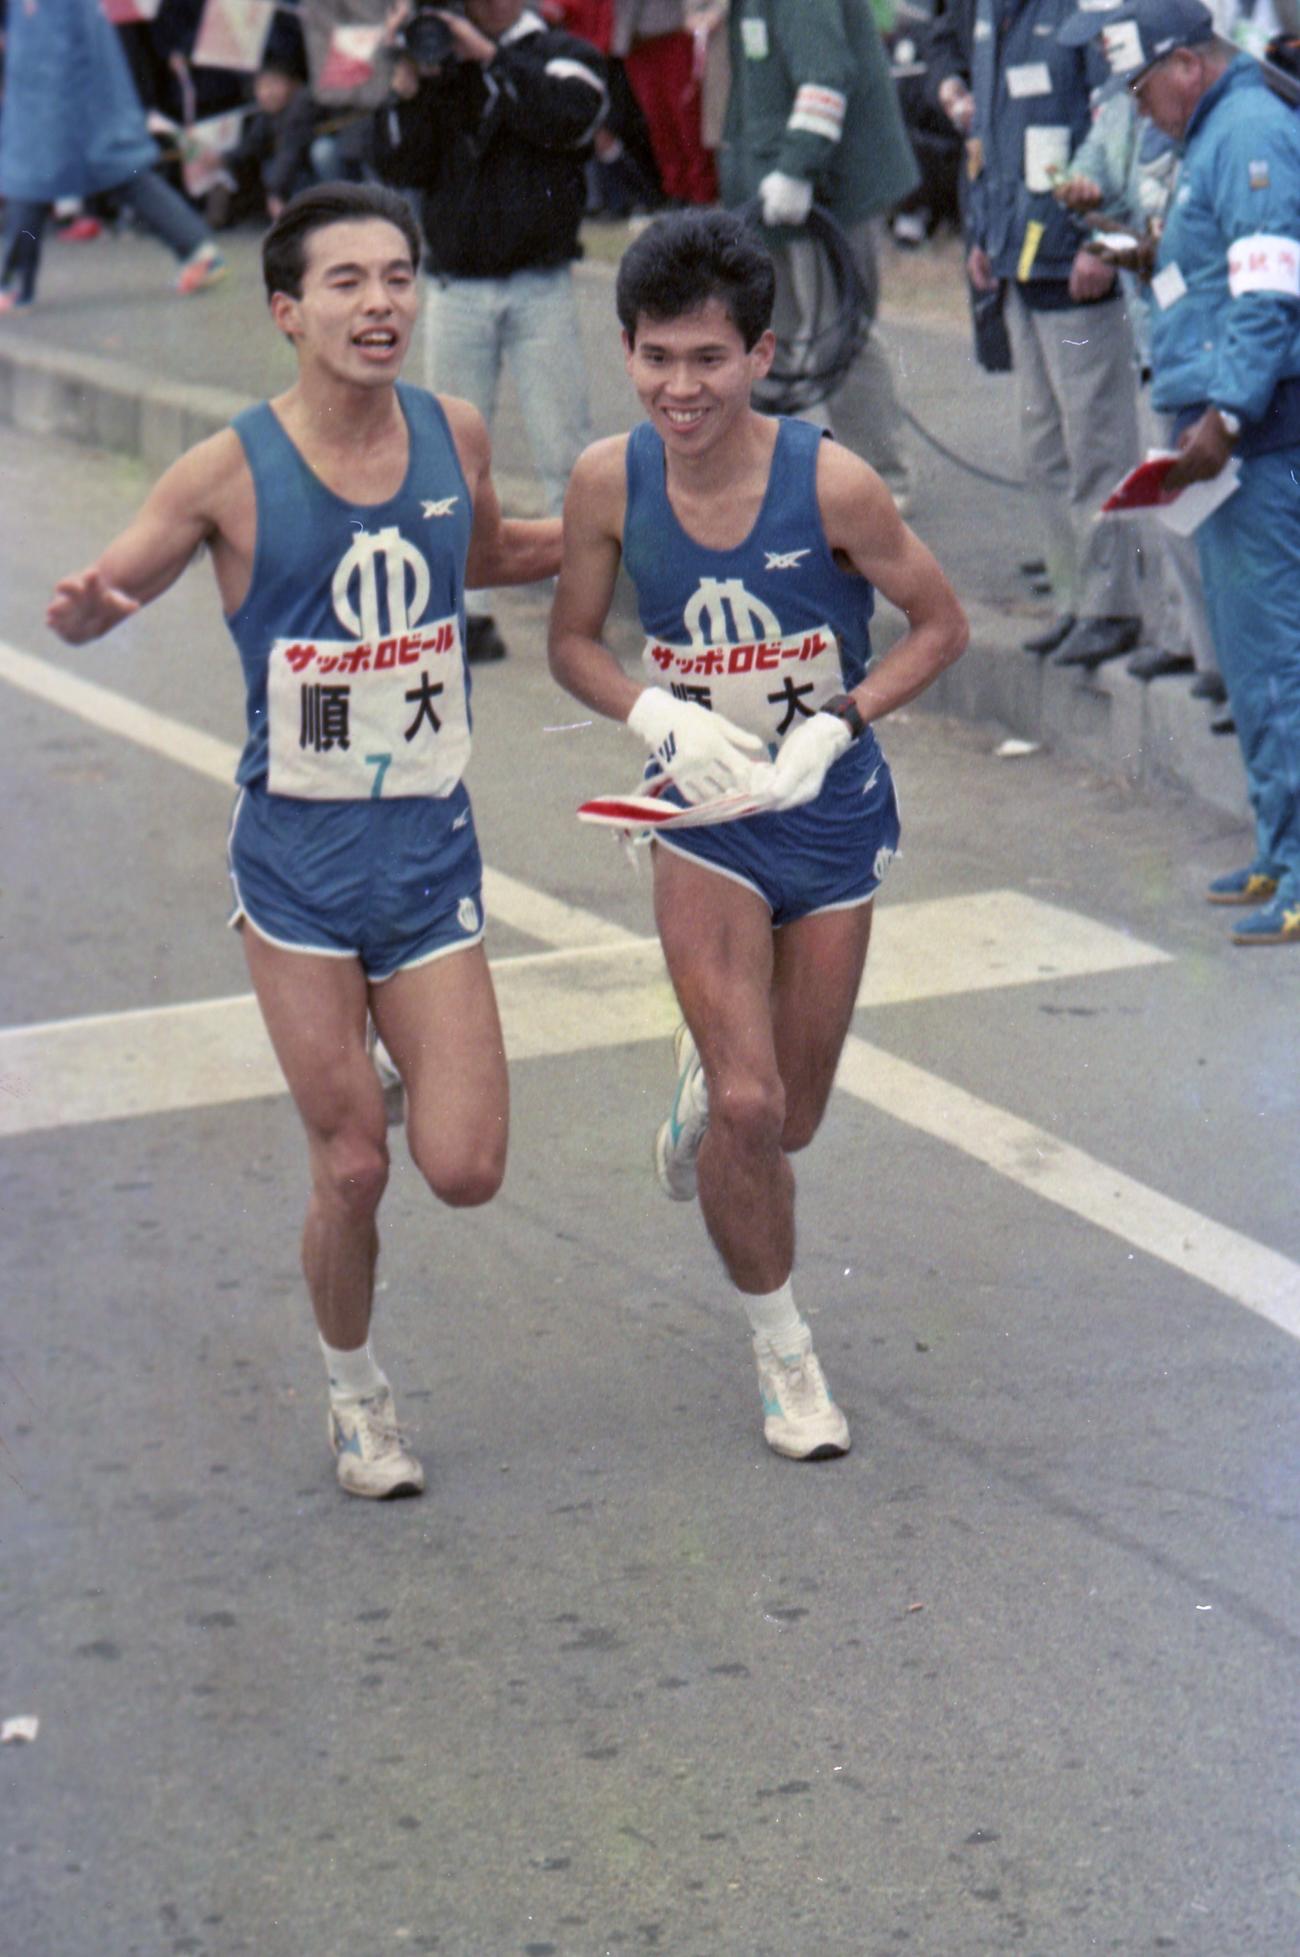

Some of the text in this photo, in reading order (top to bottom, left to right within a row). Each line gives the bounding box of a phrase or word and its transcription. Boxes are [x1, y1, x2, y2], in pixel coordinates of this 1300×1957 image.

[285, 623, 454, 674] サッポロビール
[652, 632, 828, 675] サッポロビール
[365, 753, 392, 800] 7
